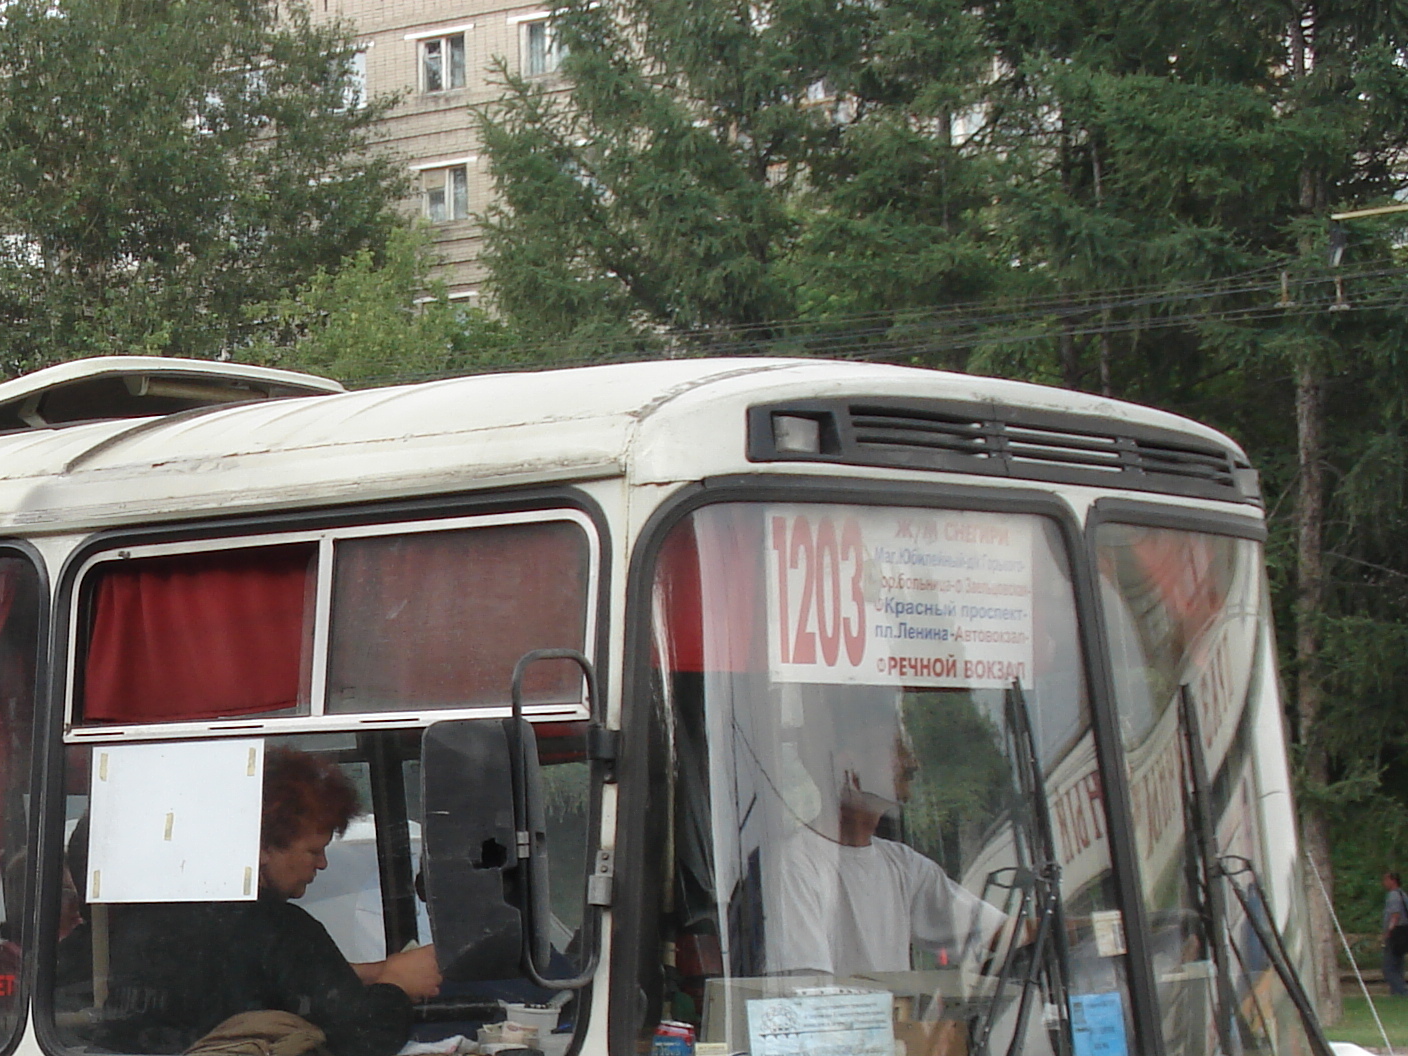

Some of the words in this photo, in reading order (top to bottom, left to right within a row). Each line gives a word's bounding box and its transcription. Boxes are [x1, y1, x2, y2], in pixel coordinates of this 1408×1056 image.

[772, 515, 866, 667] 1203
[885, 597, 956, 618] Красный
[888, 653, 957, 679] РЕЧНОЙ
[963, 659, 1026, 681] ВОКЗАЛ
